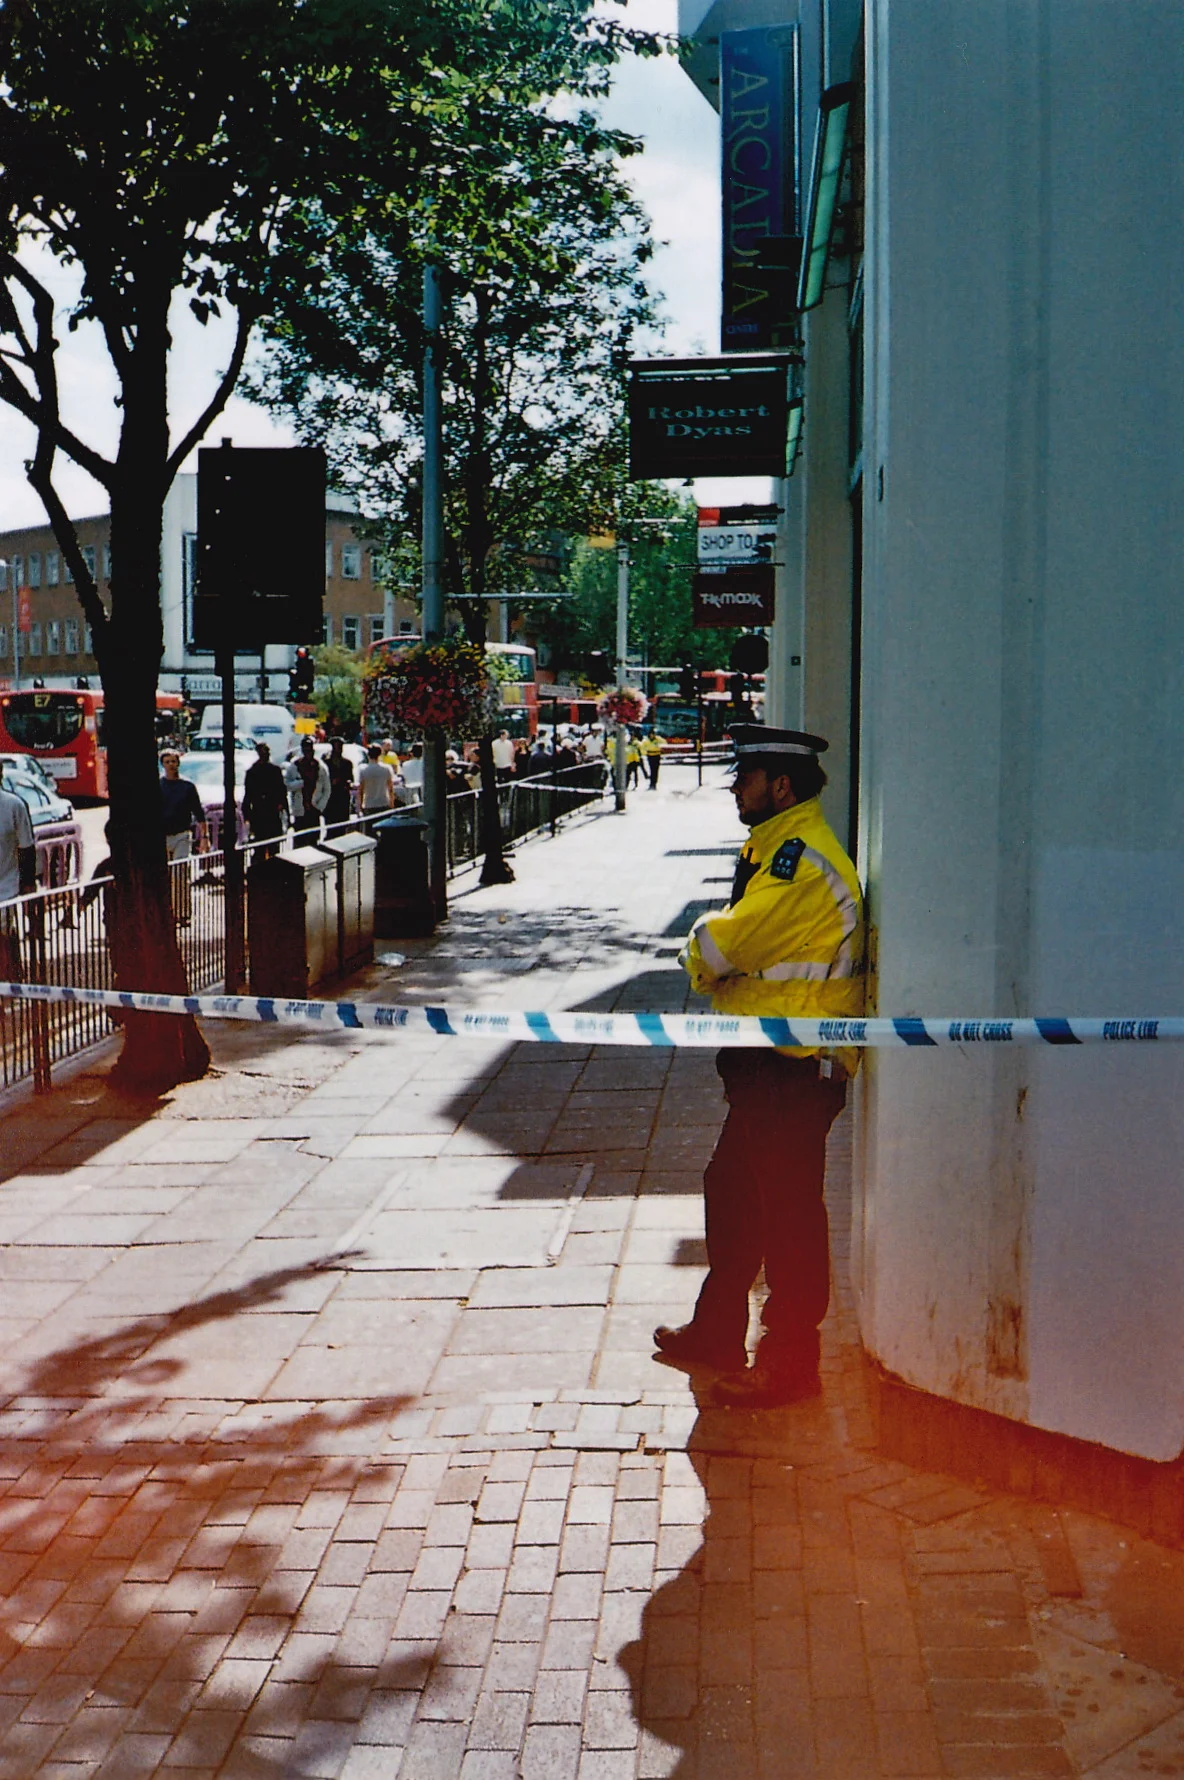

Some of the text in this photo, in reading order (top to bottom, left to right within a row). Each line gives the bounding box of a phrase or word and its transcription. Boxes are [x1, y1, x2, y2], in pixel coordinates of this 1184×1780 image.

[729, 65, 772, 316] ARCADIA
[648, 405, 770, 419] Robert
[666, 424, 752, 439] Dyas
[701, 534, 734, 550] SHOP
[737, 533, 753, 549] TO
[34, 694, 51, 708] E7
[1103, 1020, 1160, 1041] POLICE LINE
